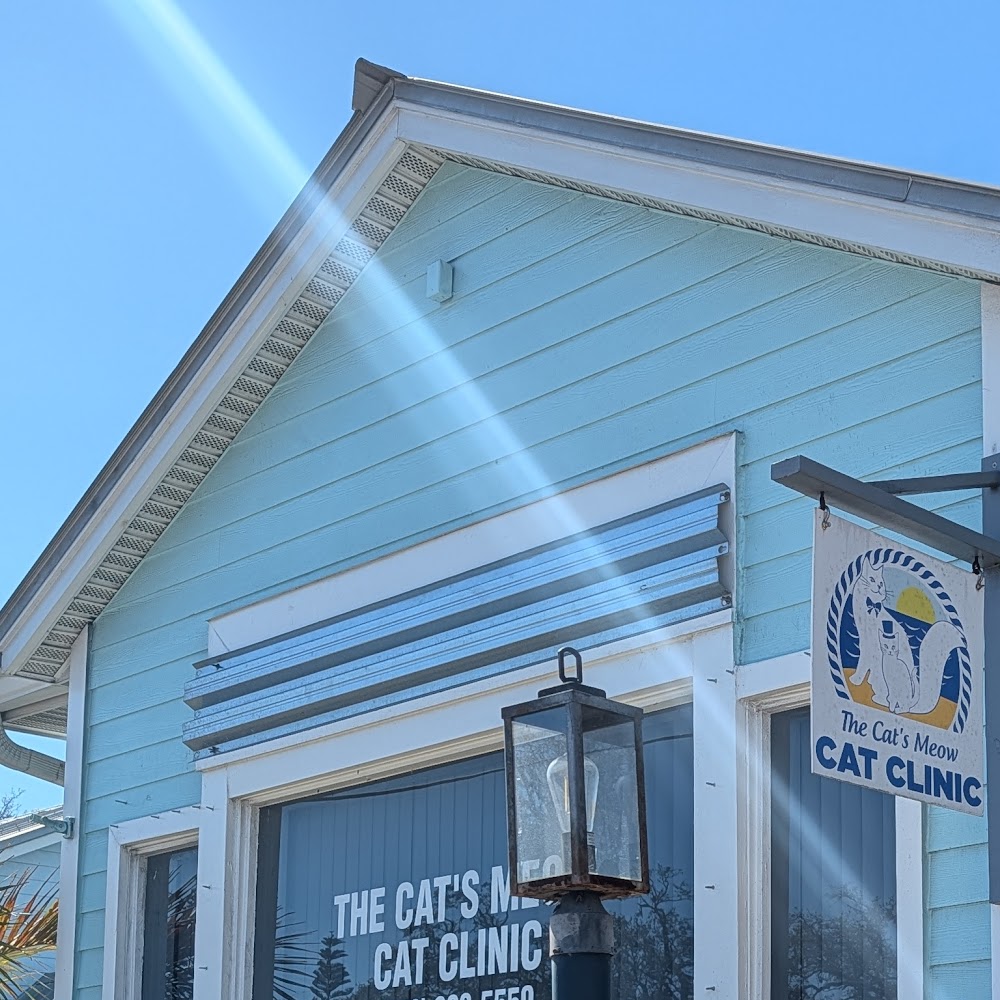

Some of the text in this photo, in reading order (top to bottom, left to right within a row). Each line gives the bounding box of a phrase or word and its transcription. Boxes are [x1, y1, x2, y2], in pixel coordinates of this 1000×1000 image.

[815, 736, 982, 807] CAT CLINIC
[841, 710, 959, 762] The Cat's Meow
[334, 854, 564, 939] THE CAT'S MEO
[374, 920, 542, 991] CAT CLINIC
